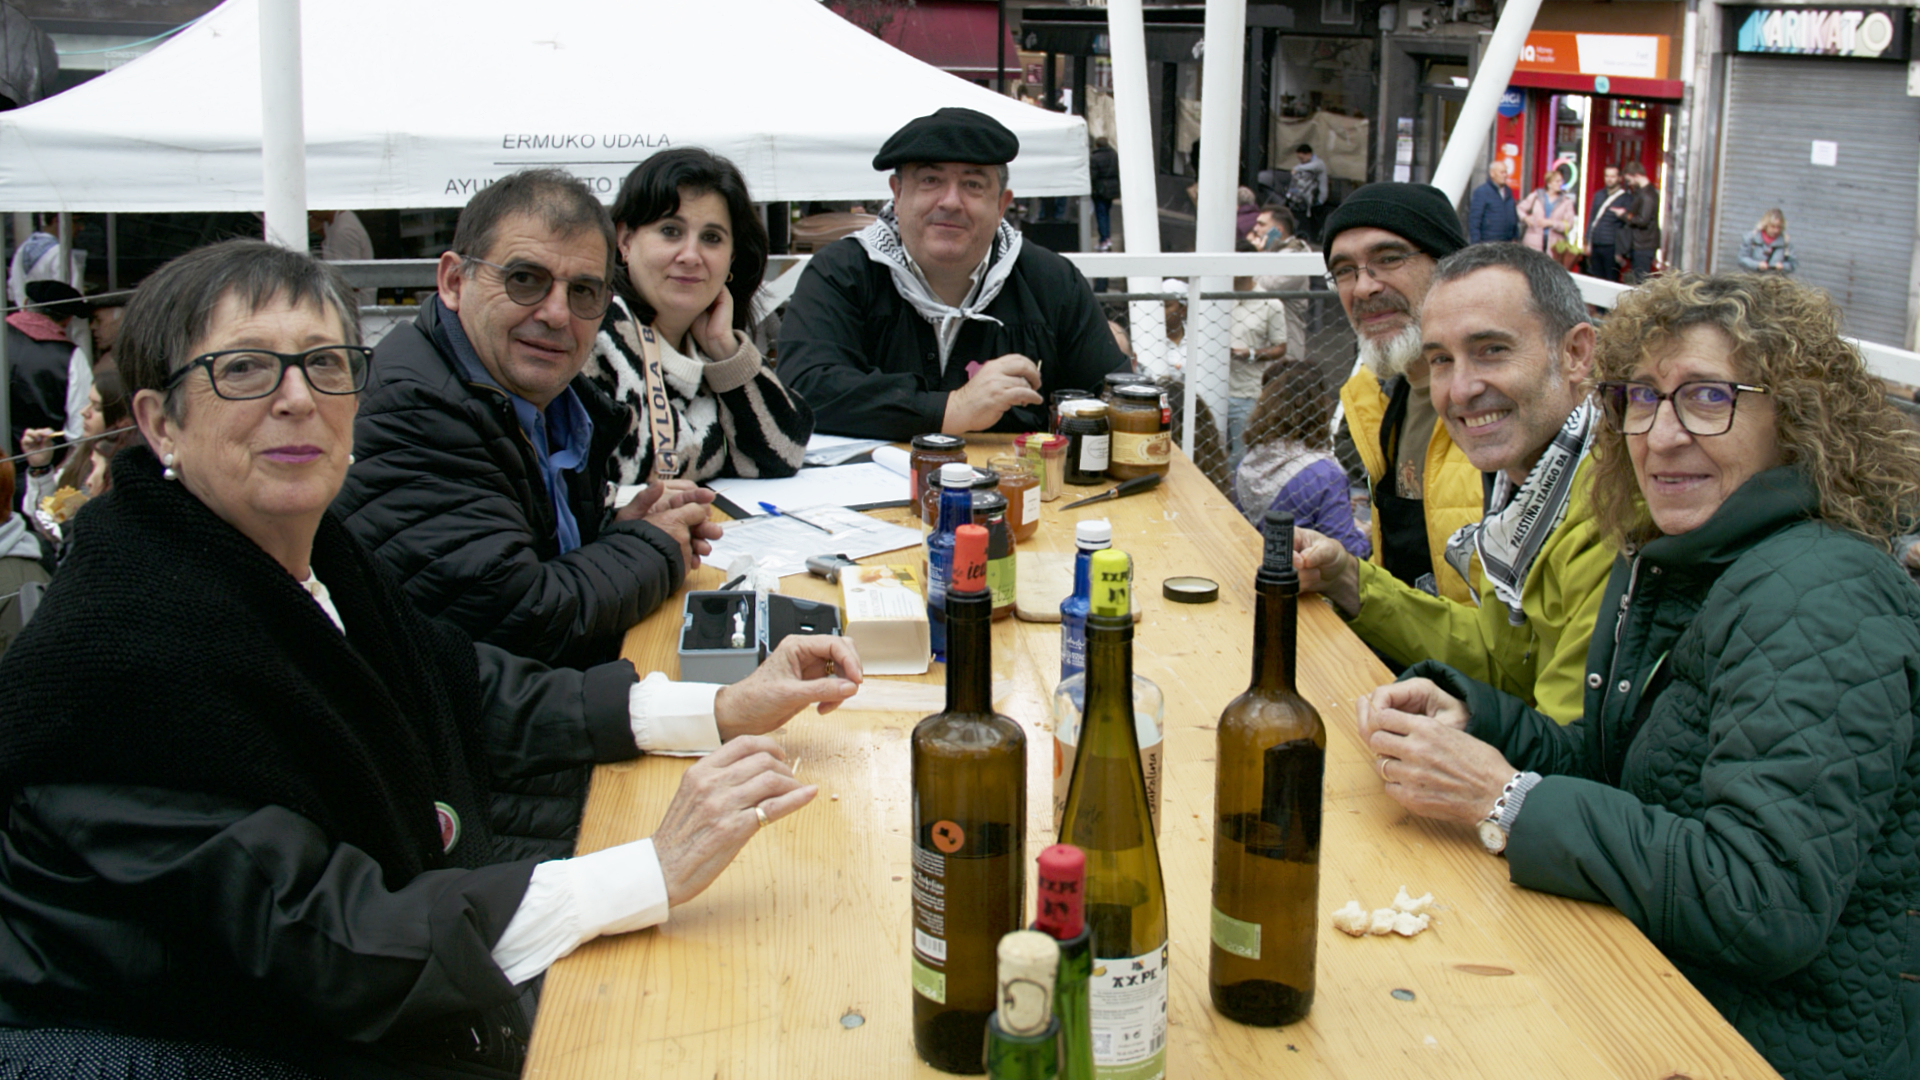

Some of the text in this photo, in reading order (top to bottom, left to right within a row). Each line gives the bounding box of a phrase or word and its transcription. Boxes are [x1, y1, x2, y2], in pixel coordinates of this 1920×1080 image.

[1740, 9, 1894, 55] KARIKATO
[1519, 45, 1536, 62] ia
[502, 133, 671, 150] ERMUKO UDALA
[650, 361, 669, 424] LOLA
[1510, 453, 1569, 549] PALESTINA IZANGO DA
[1112, 967, 1158, 989] AXPE
